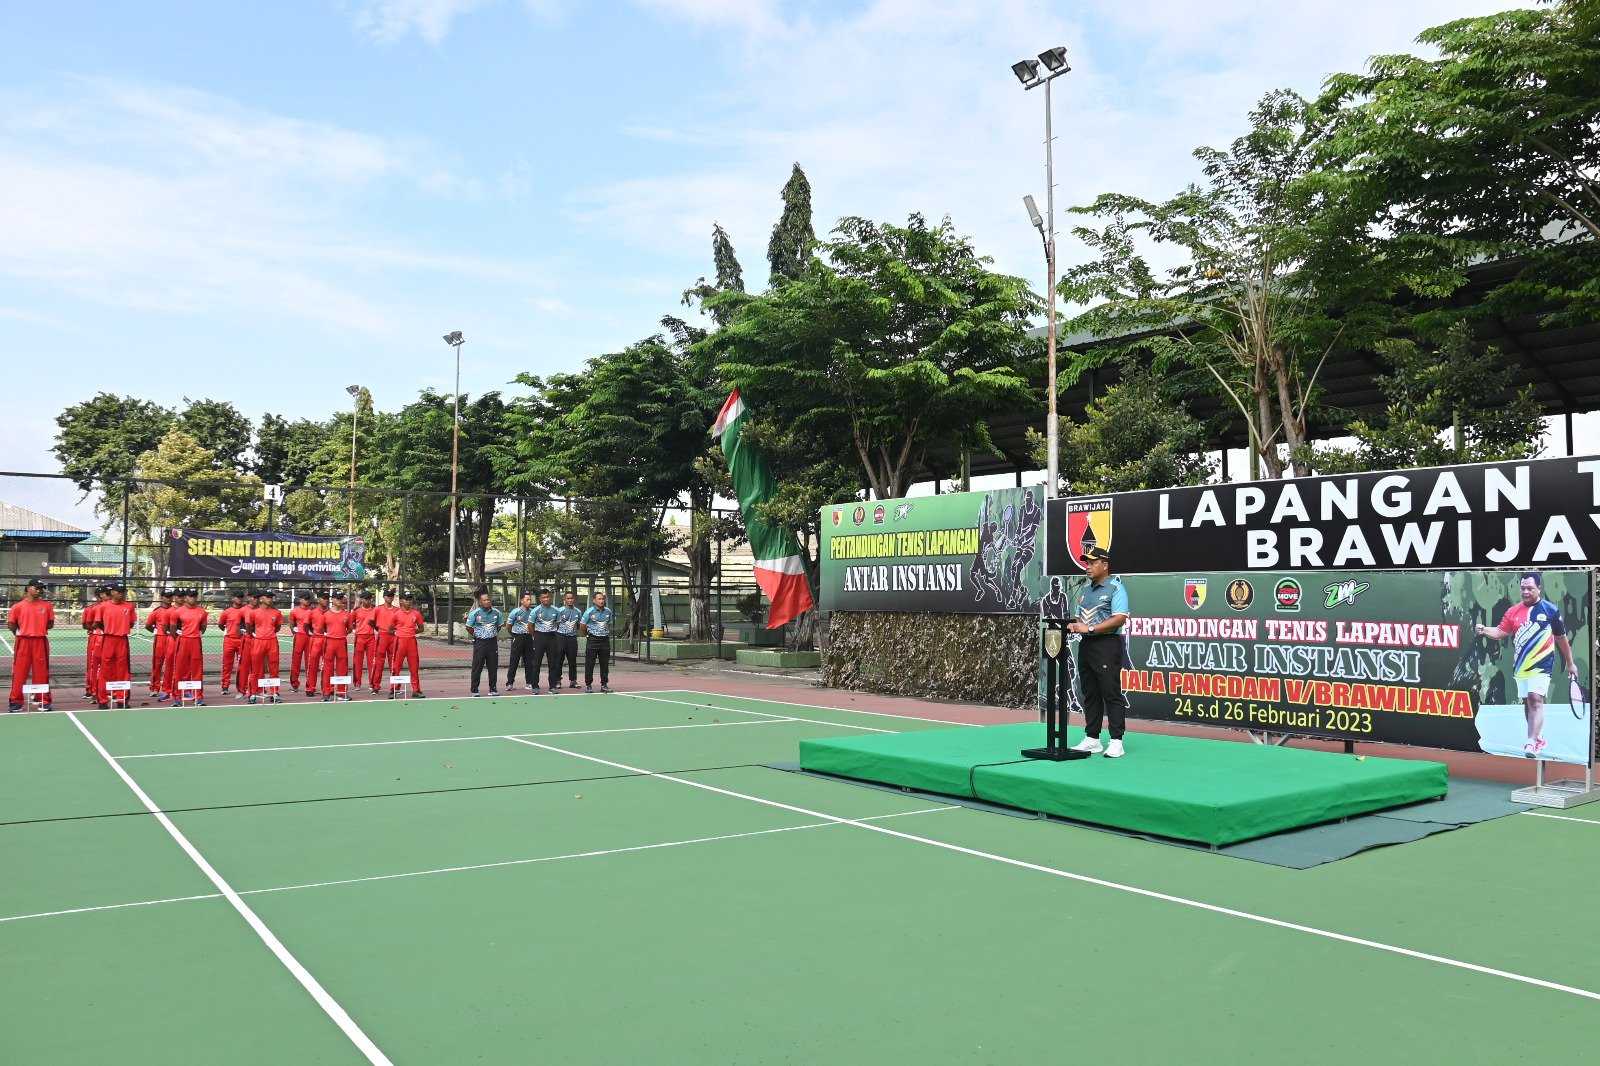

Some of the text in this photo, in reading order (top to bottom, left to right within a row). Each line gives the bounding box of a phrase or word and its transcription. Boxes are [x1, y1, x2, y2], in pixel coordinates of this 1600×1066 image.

[268, 487, 275, 498] 4
[1068, 502, 1110, 513] BRAWIJAYA
[1158, 465, 1531, 531] LAPANGAN
[187, 538, 341, 560] SELAMAT BERTANDING
[829, 527, 979, 560] PERTANDINGAN TENIS LAPANGAN
[1246, 513, 1600, 569] BRAWIJA
[231, 559, 341, 575] Junjung tinggi sportivitas
[843, 563, 963, 592] ANTAR INSTANSI
[1121, 616, 1460, 649] PERTANDINGAN TENIS LAPANGAN
[1146, 640, 1420, 683] ANTAR INSTANSI
[1120, 669, 1475, 718] IALA PANGDAM V/BRAWIJAYA
[1174, 697, 1373, 733] 24 s.d 26 Februari 2023
